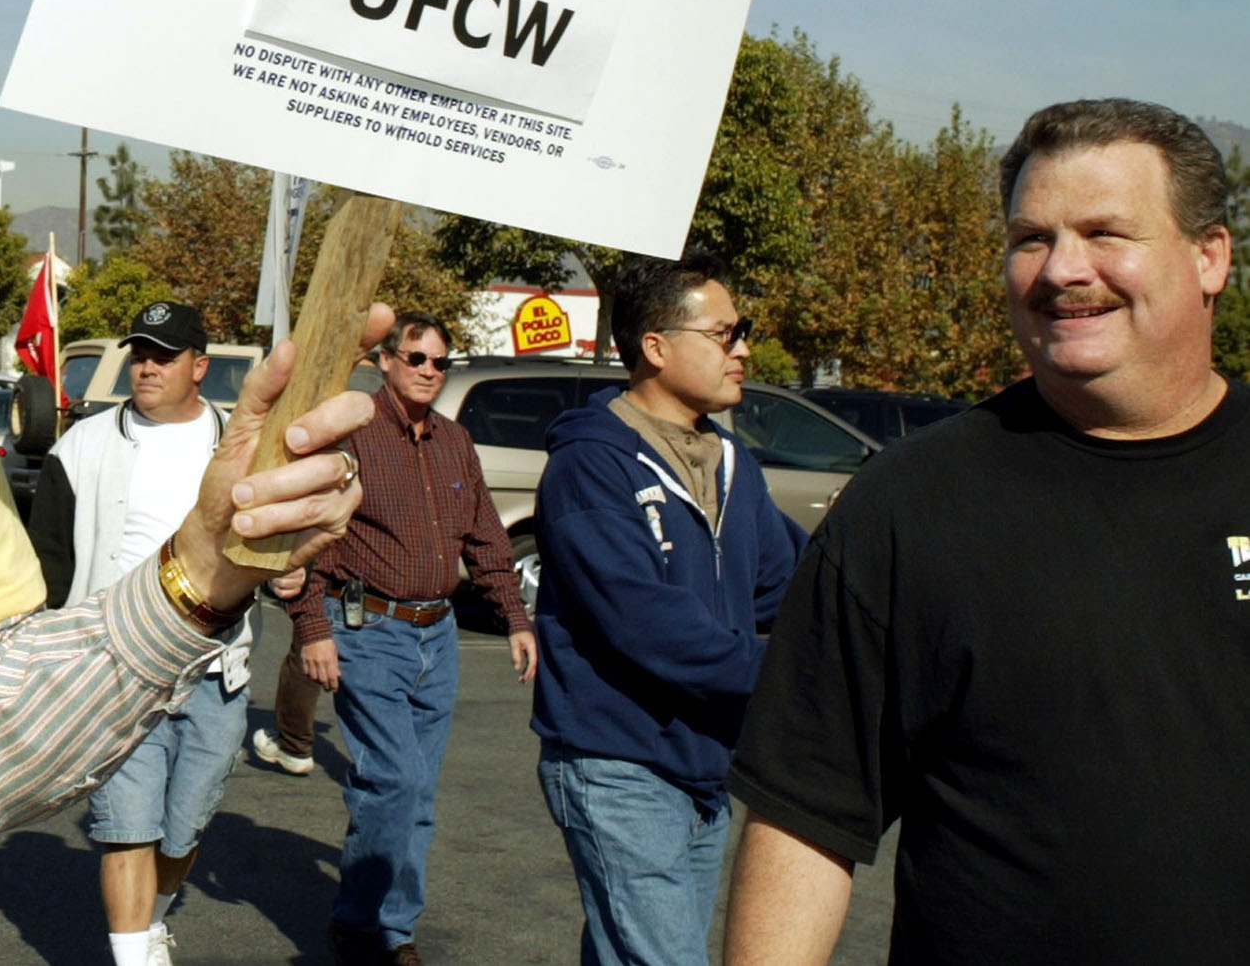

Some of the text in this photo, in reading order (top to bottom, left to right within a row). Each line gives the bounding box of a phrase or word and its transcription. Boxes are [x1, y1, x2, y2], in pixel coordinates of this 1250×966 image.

[233, 63, 564, 158] WE ARE NOT ASKING ANY EMPLOYEES, VENDORS, OR
[234, 43, 573, 141] NO DISPUTE WITH ANY OTHER EMPLOYER AT THIS SITE.
[286, 99, 506, 163] SUPPLIERS TO WITHOLD SERVICES
[522, 317, 562, 332] POLLO
[533, 306, 548, 317] EL
[527, 330, 561, 344] LOCO
